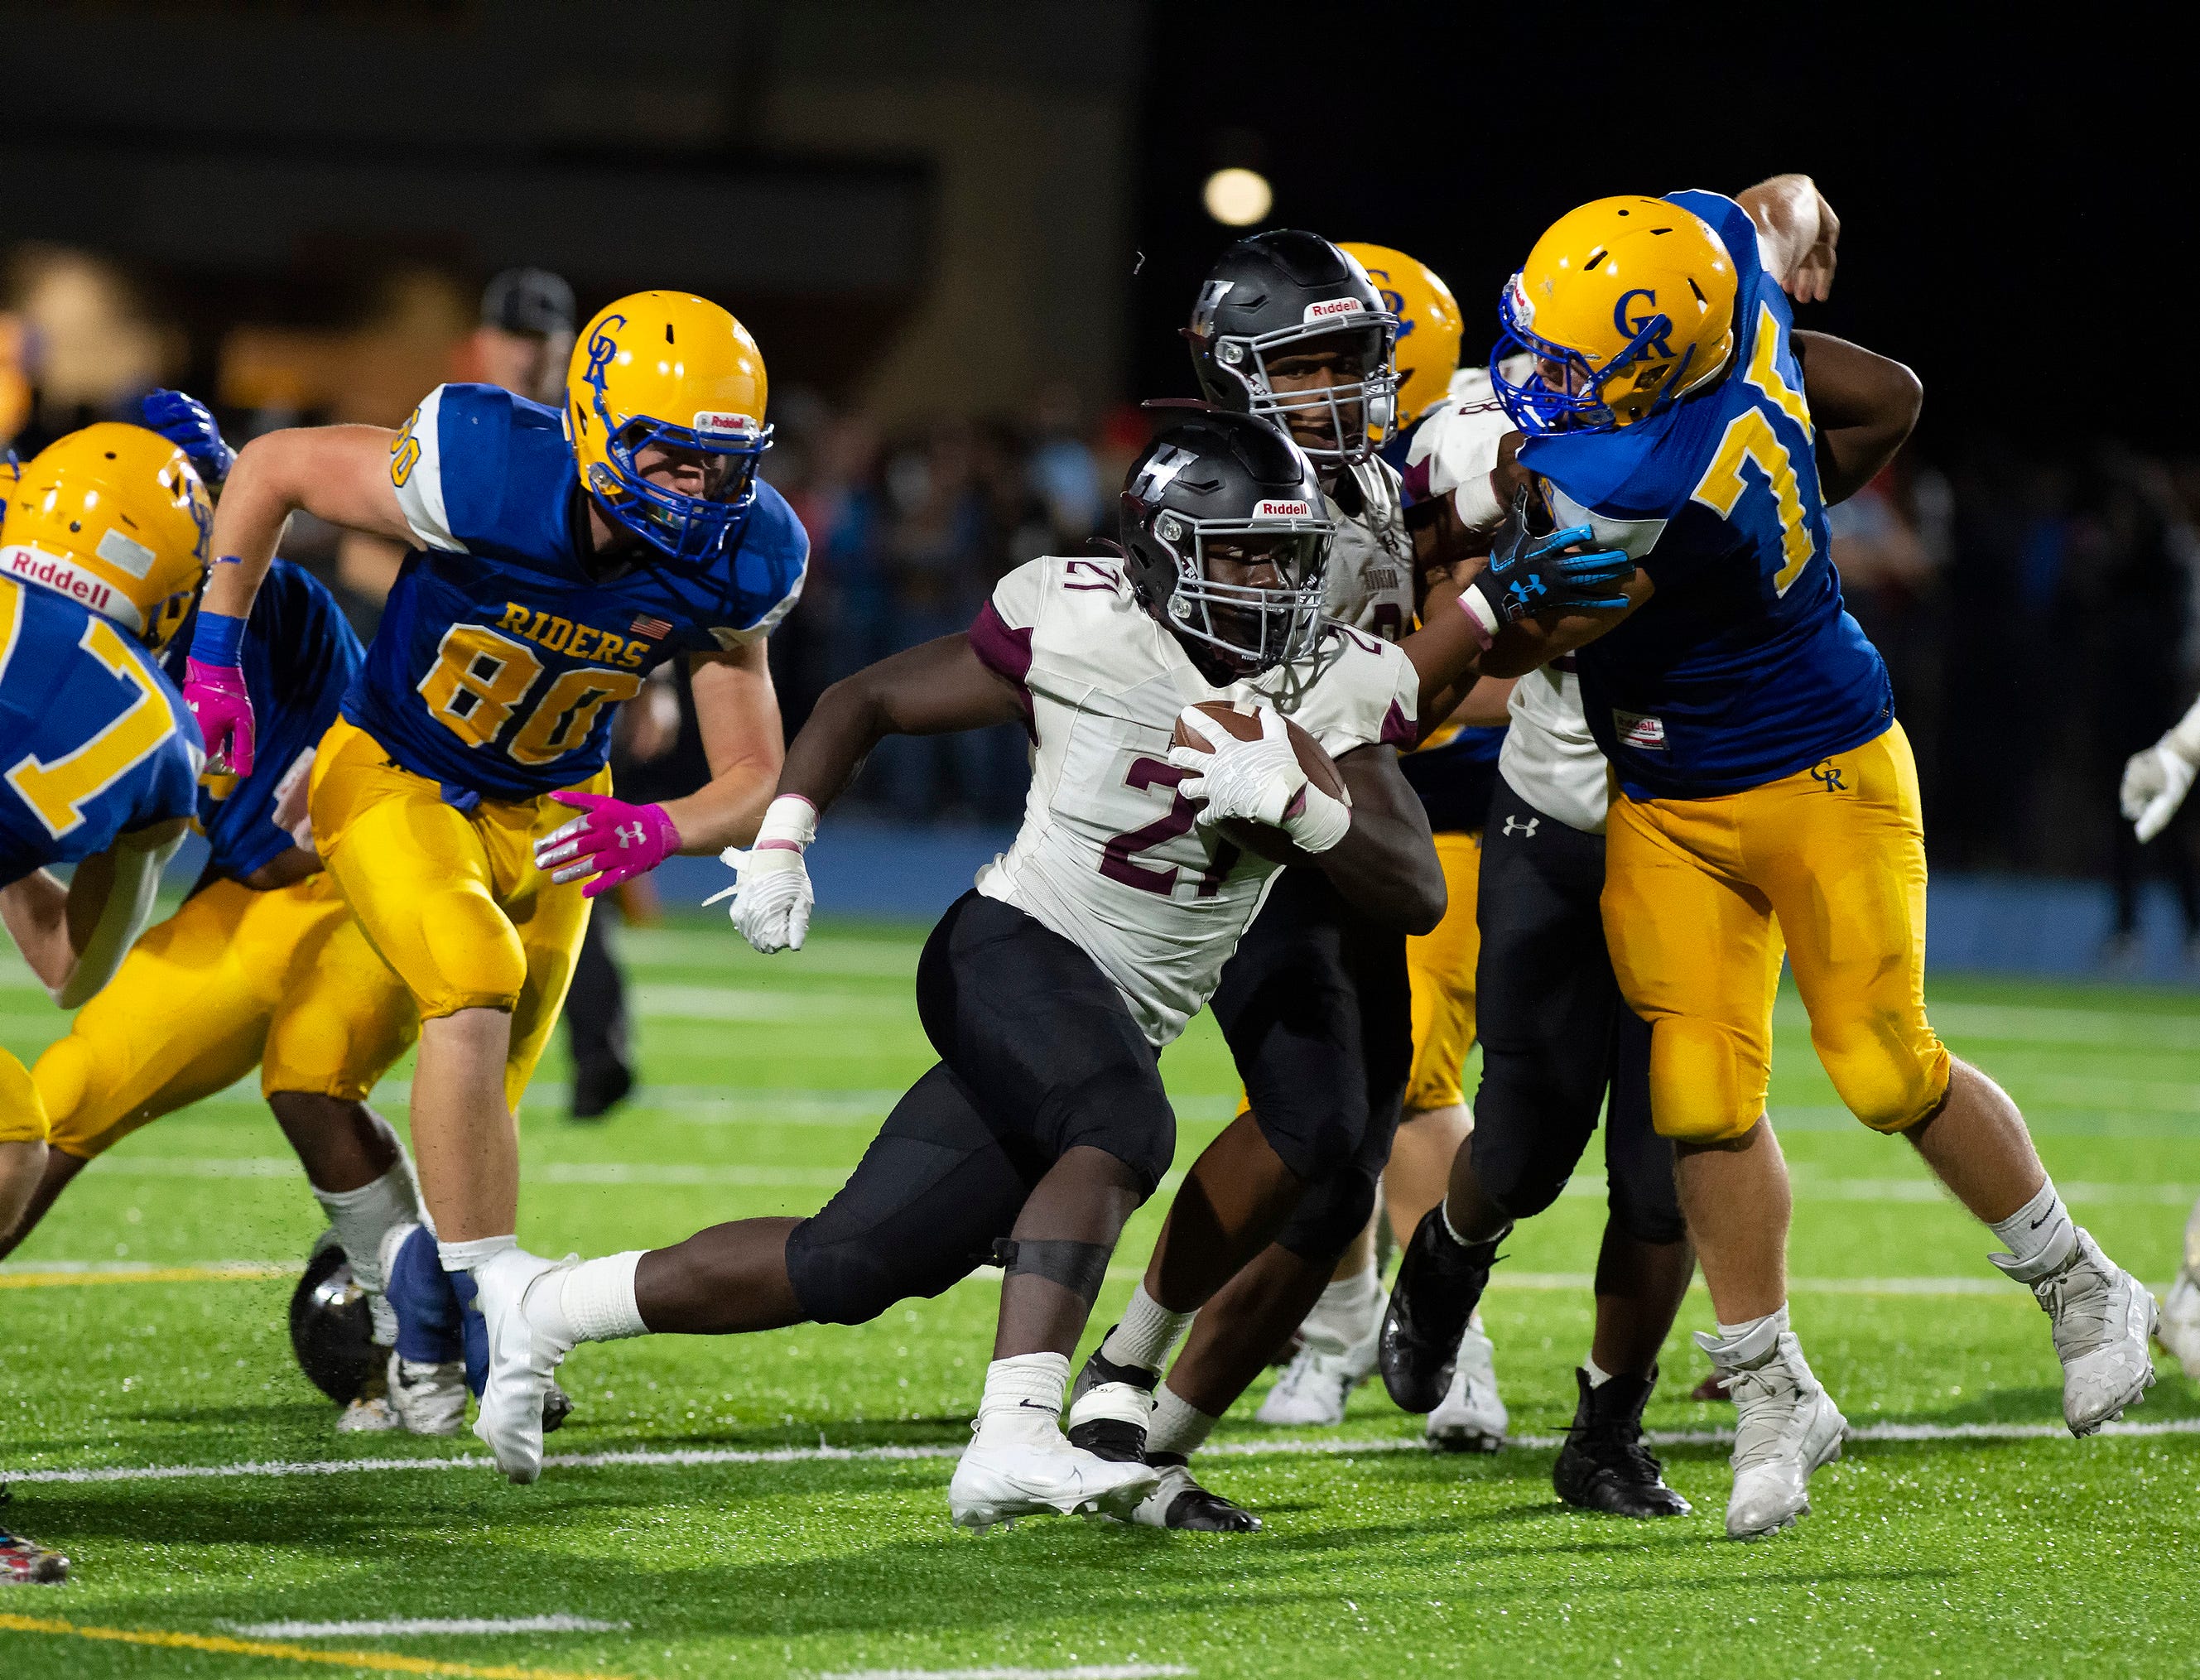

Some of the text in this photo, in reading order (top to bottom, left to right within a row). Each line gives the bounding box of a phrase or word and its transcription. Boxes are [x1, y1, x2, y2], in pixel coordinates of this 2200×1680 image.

[1312, 300, 1358, 316] Riddell
[1263, 503, 1307, 515] Riddell
[12, 551, 111, 609] Riddell
[1063, 561, 1121, 599] 21
[496, 602, 651, 667] RIDERS
[416, 623, 646, 765] 80
